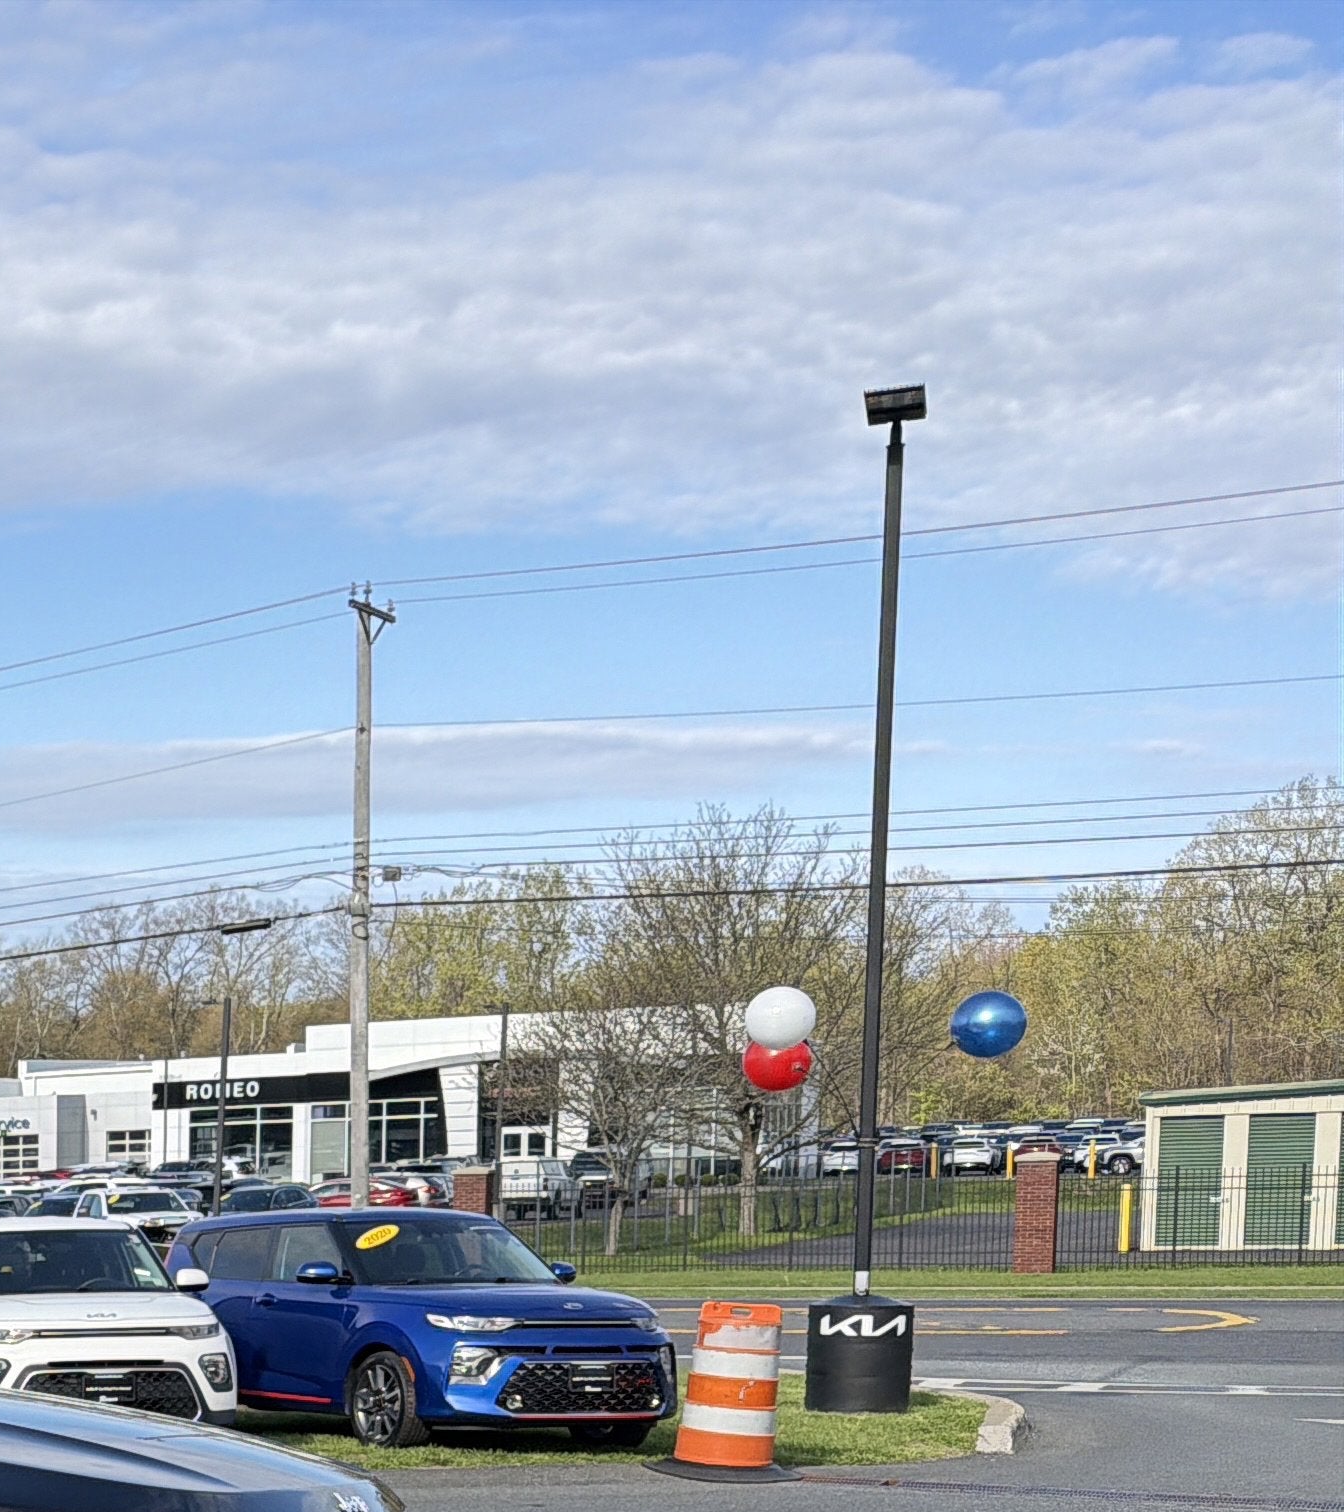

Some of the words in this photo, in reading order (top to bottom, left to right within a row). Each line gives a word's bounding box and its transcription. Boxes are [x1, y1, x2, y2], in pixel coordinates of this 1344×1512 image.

[185, 1081, 260, 1100] ROMEO
[363, 1227, 392, 1246] 2020
[819, 1313, 907, 1337] KIA
